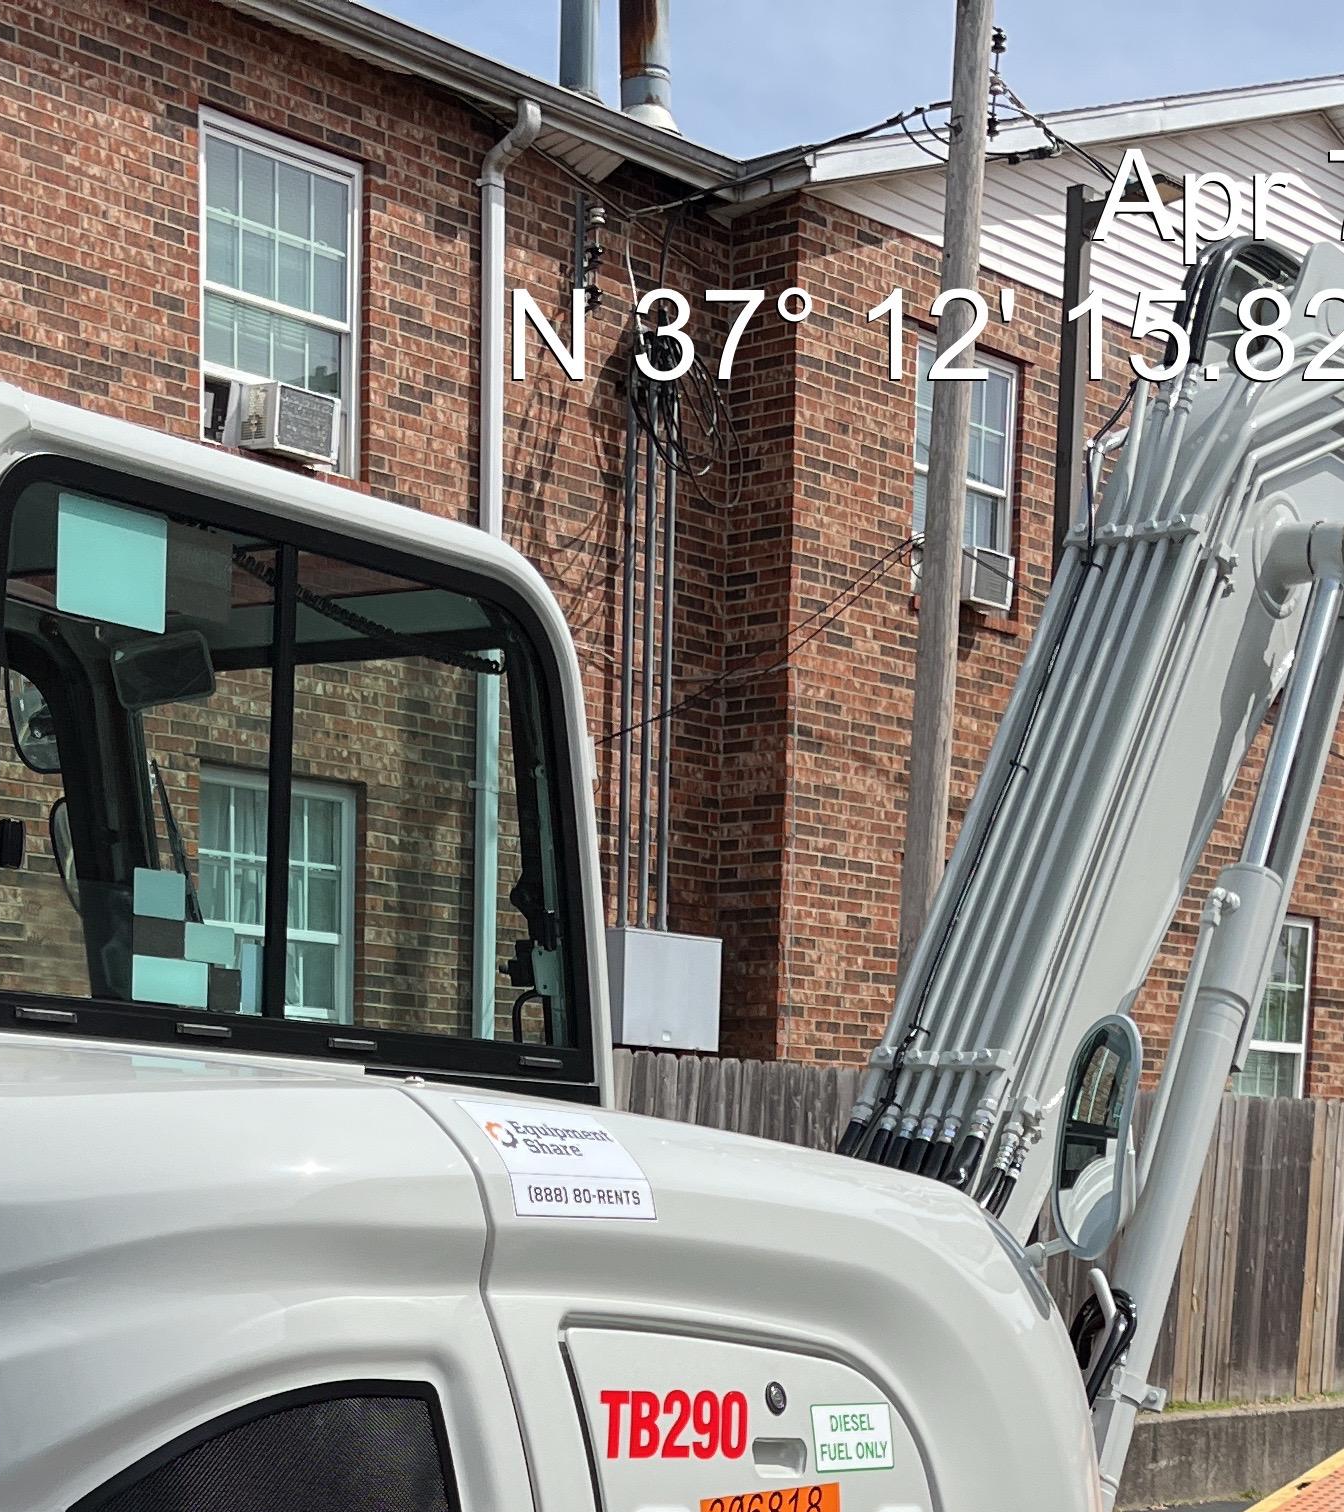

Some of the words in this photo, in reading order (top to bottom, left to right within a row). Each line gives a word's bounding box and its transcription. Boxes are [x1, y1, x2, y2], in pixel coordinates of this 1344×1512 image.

[507, 1120, 615, 1143] Equipment
[523, 1139, 583, 1157] Share
[528, 1185, 569, 1204] (888)
[573, 1188, 641, 1205] 80-RENTS
[599, 1388, 748, 1460] TB290
[829, 1413, 875, 1433] DIESEL
[820, 1441, 853, 1462] FUEL
[855, 1440, 888, 1462] ONLY
